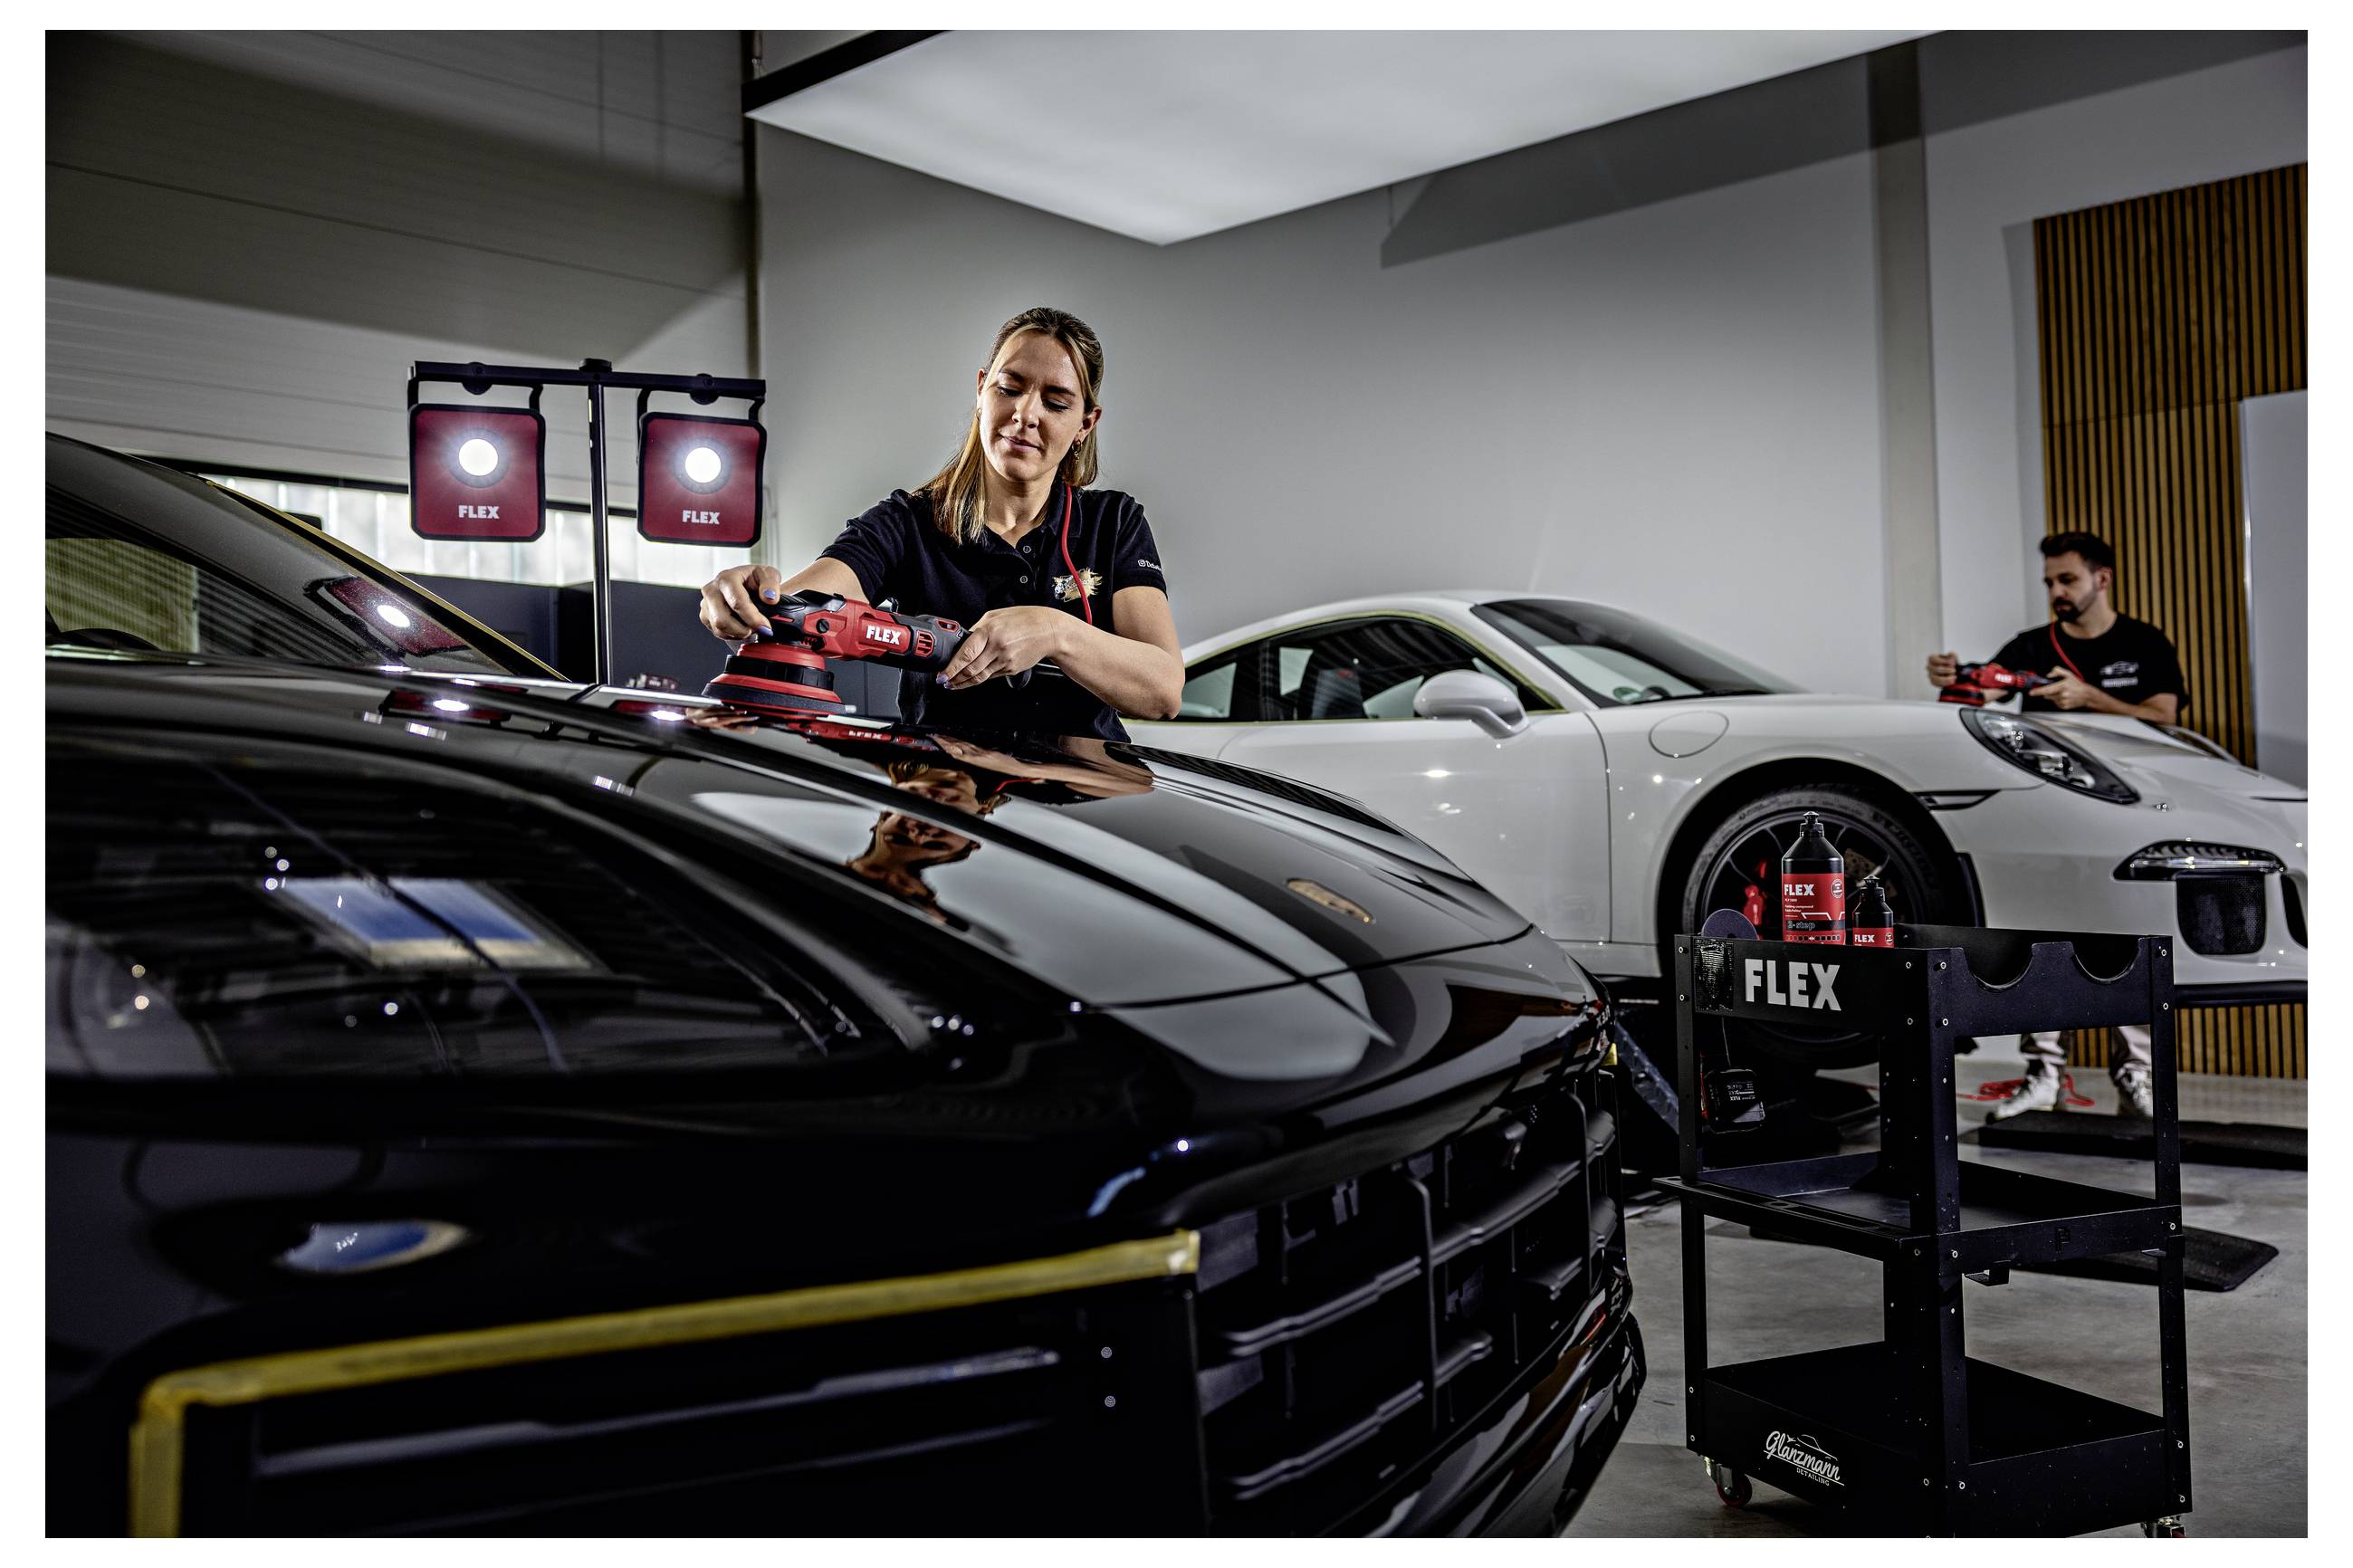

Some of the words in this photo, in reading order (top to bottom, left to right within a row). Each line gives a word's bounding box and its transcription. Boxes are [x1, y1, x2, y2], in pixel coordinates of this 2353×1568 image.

[458, 504, 500, 520] FLEX
[682, 510, 721, 525] FLEX
[866, 625, 902, 645] FLEX
[1784, 884, 1814, 896] FLEX
[1854, 933, 1876, 943] FLEX
[1745, 958, 1841, 1011] FLEX
[1766, 1430, 1841, 1481] Glanzmann
[1796, 1468, 1830, 1487] DETAILING
